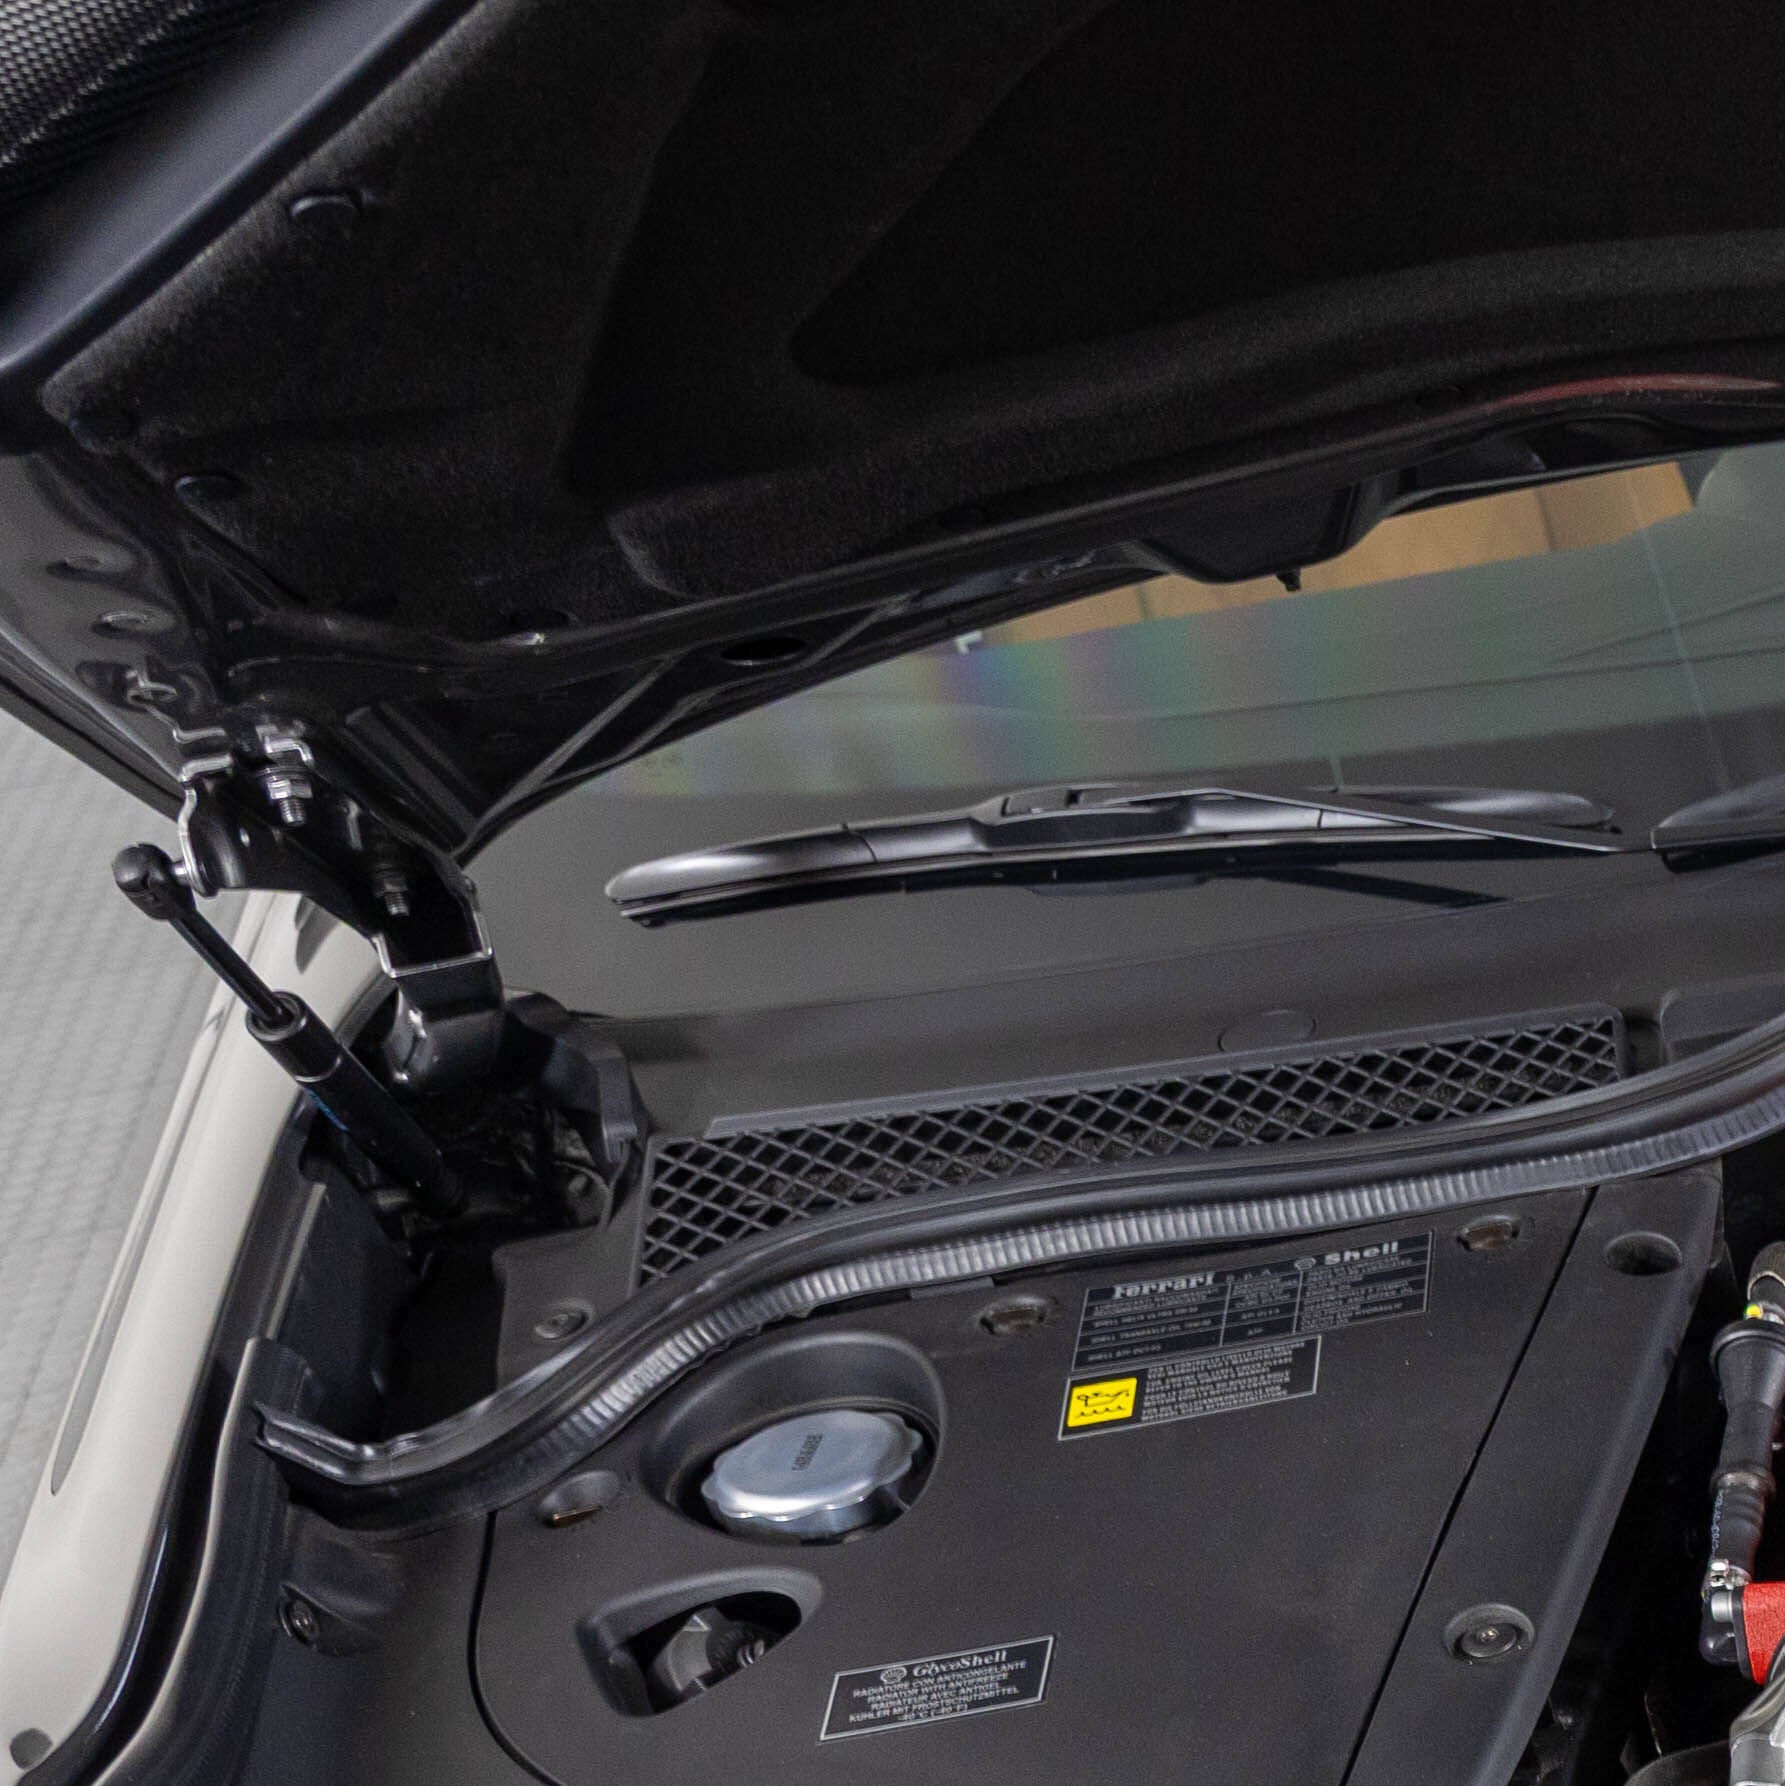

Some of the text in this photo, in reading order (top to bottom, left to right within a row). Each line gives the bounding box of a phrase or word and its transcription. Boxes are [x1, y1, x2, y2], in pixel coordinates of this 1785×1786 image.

[1325, 1241, 1398, 1265] Shell
[1112, 1271, 1216, 1299] Ferrari
[911, 1649, 1008, 1678] GlycoShell
